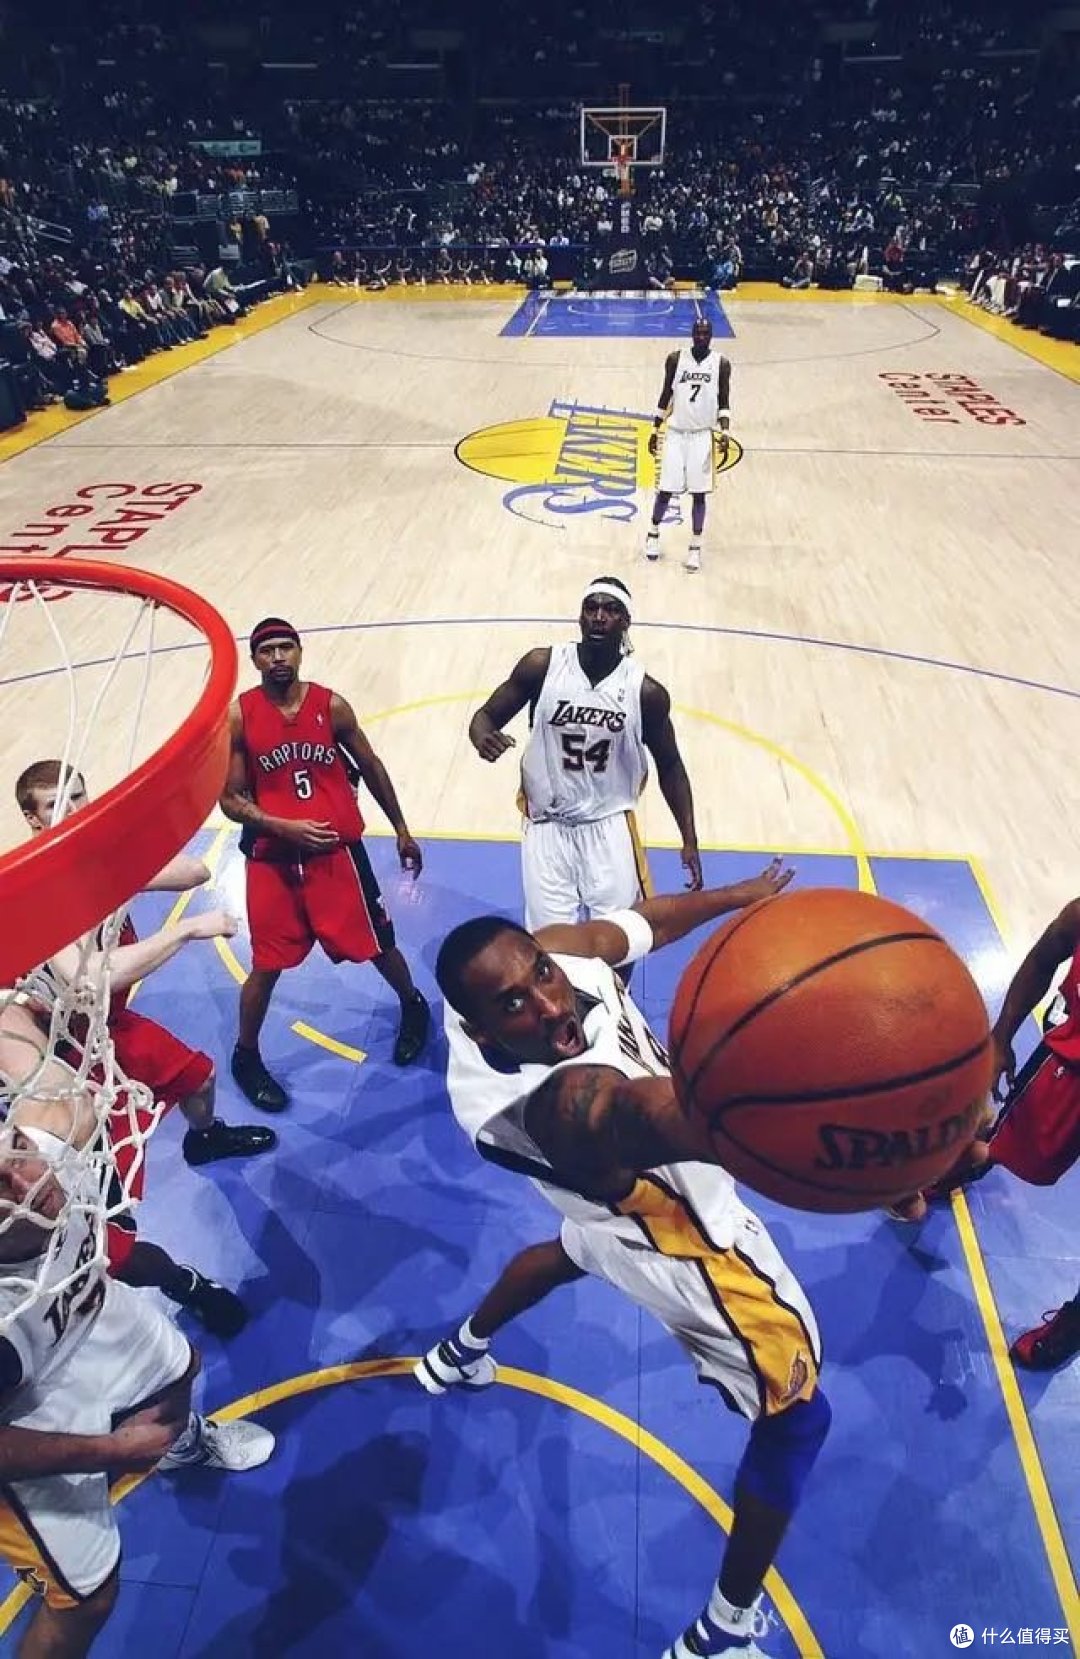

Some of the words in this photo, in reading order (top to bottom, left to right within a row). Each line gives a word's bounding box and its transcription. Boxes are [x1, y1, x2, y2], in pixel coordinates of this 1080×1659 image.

[689, 384, 702, 403] 7
[878, 372, 961, 424] Center
[925, 372, 1027, 426] STAPLES
[548, 699, 627, 732] LAKERS
[258, 741, 338, 773] RAPTORS
[561, 733, 612, 773] 54
[294, 769, 314, 801] 5
